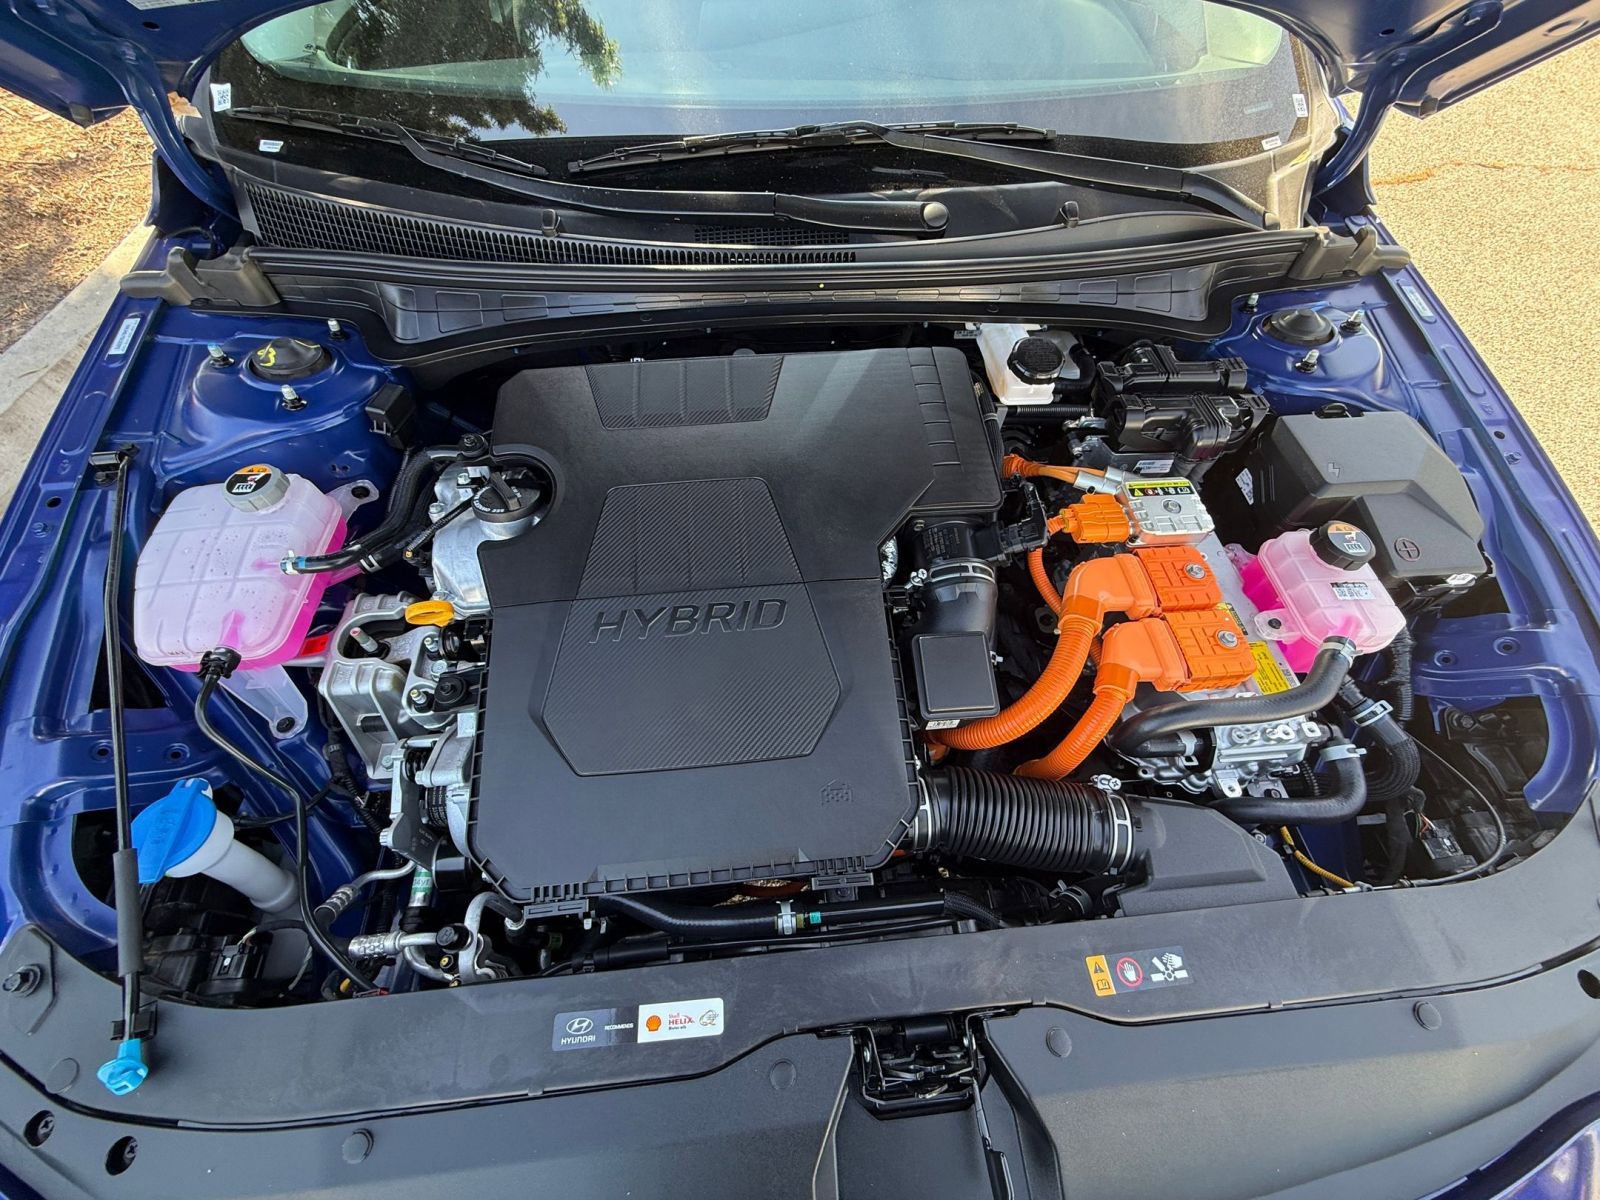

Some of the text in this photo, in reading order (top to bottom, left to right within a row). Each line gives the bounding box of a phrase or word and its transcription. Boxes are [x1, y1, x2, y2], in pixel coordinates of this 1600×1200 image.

[588, 598, 788, 644] HYBRID
[668, 1016, 693, 1026] HELIX
[560, 1034, 596, 1046] HYUNDAI
